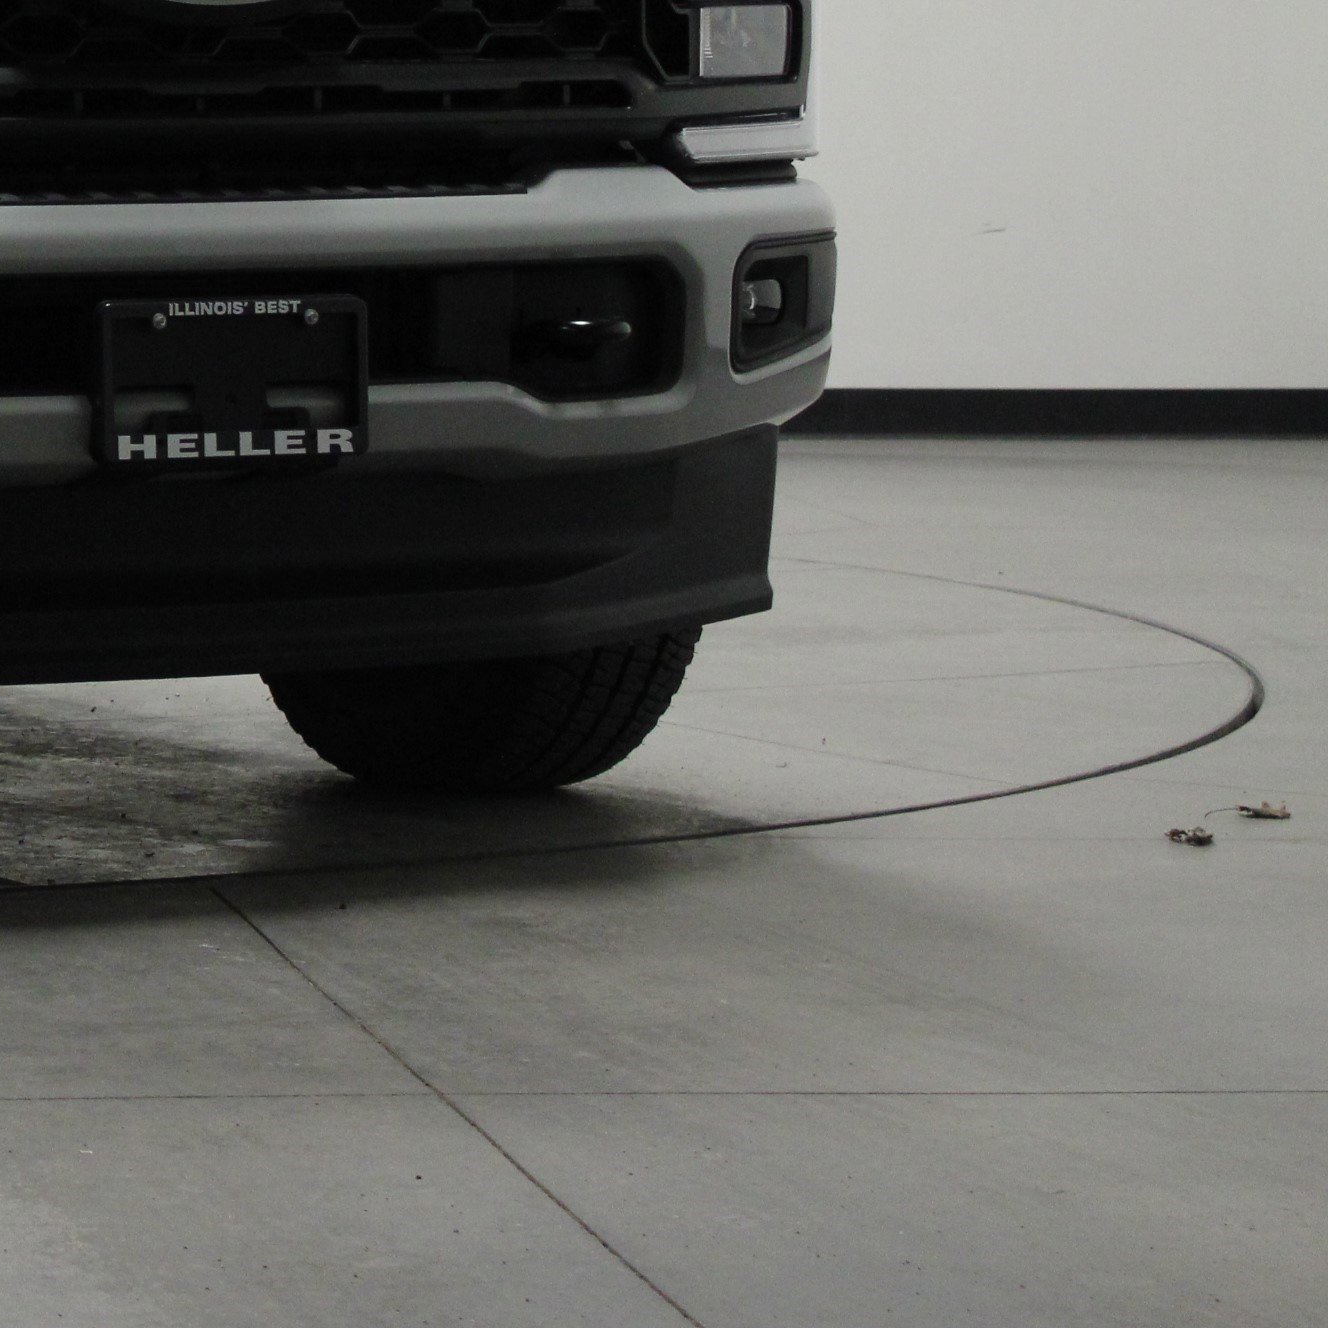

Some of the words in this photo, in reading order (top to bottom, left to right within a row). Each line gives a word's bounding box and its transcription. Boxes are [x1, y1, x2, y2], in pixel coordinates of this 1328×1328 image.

[167, 301, 250, 318] ILLINOIS'
[254, 299, 302, 315] BEST
[117, 427, 355, 461] HELLER
